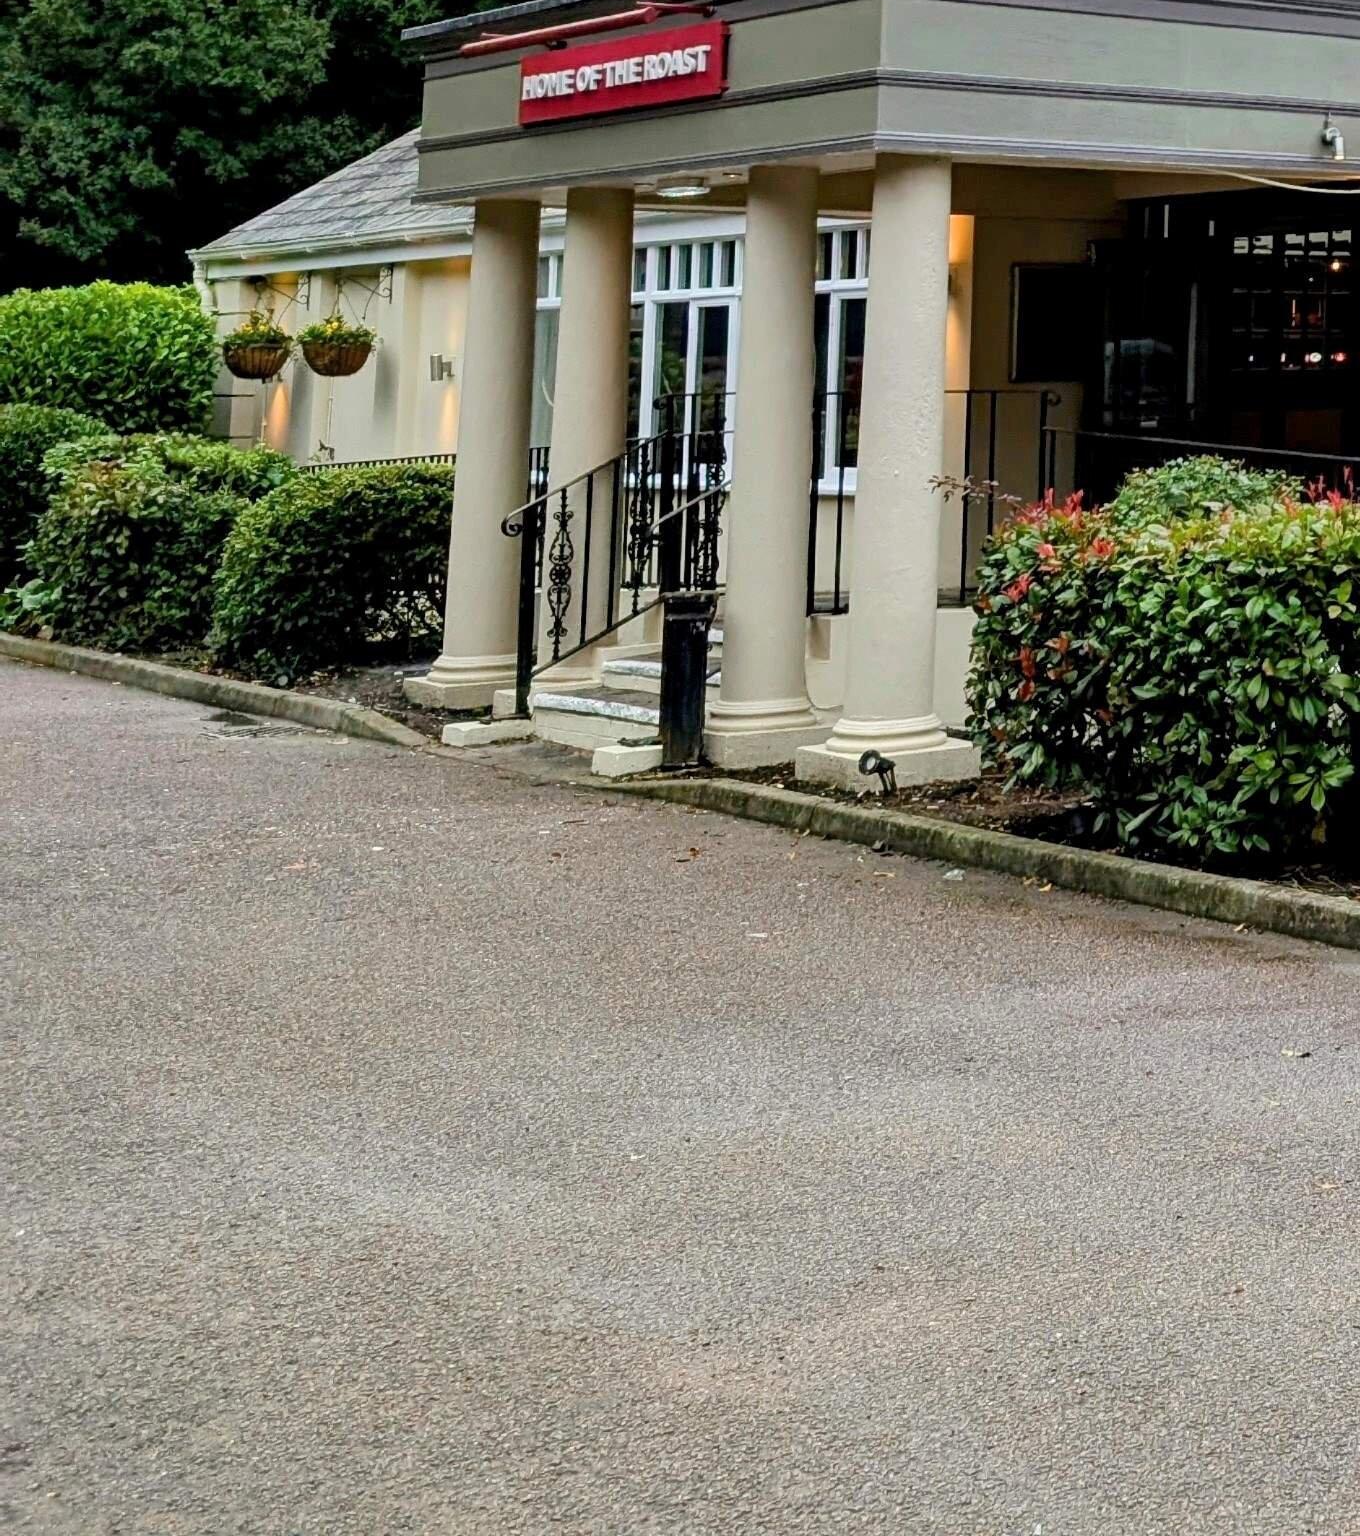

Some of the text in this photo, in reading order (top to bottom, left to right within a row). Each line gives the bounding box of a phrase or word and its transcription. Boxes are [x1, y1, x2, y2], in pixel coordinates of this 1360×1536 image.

[522, 44, 711, 101] HOME OF THE ROAST
